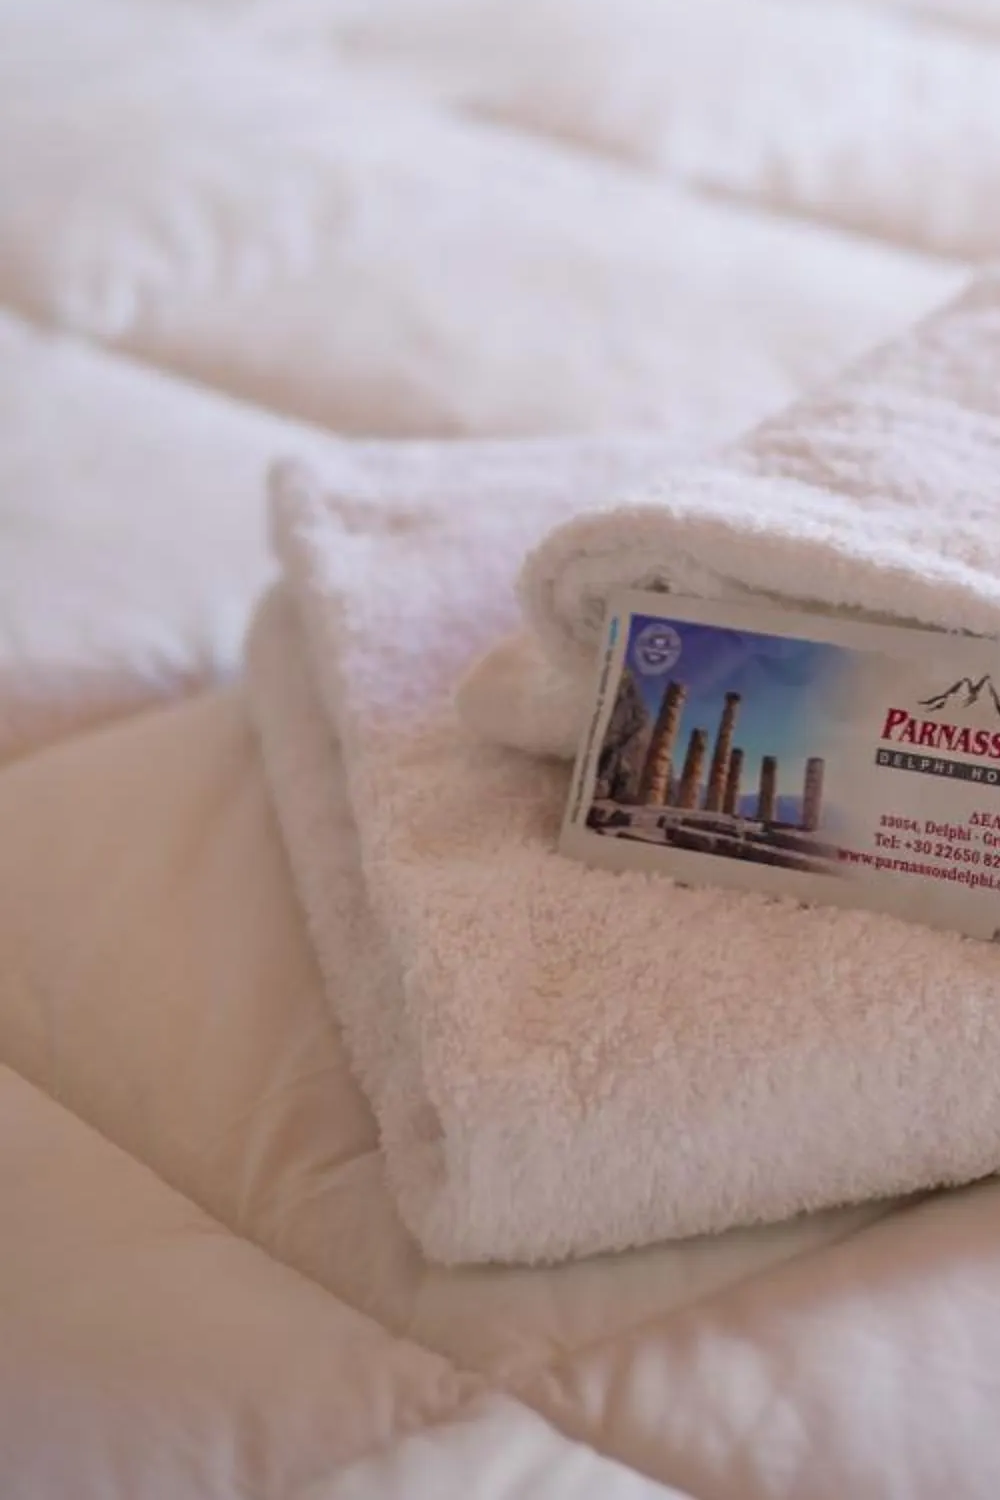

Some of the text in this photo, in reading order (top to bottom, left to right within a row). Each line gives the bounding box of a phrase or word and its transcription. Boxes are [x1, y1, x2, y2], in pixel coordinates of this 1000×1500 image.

[879, 752, 953, 774] DELPHI
[925, 820, 971, 844] Delphi
[875, 833, 900, 849] Tel:
[904, 840, 932, 855] +30
[935, 845, 980, 864] 22650
